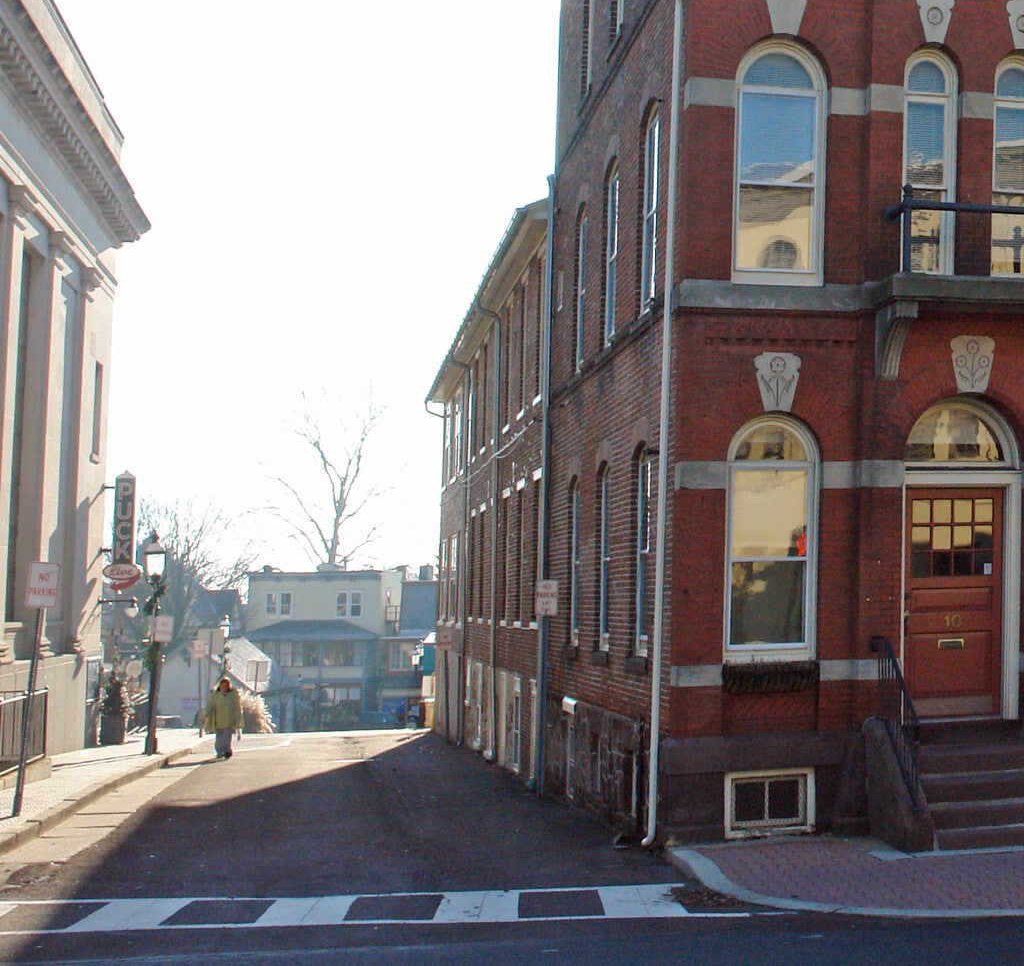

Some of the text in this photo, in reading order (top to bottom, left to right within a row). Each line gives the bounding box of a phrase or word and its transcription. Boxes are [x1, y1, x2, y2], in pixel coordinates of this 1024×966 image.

[115, 483, 134, 560] PUCK
[38, 572, 49, 582] NO
[28, 587, 57, 597] PARKING
[944, 614, 963, 628] 10
